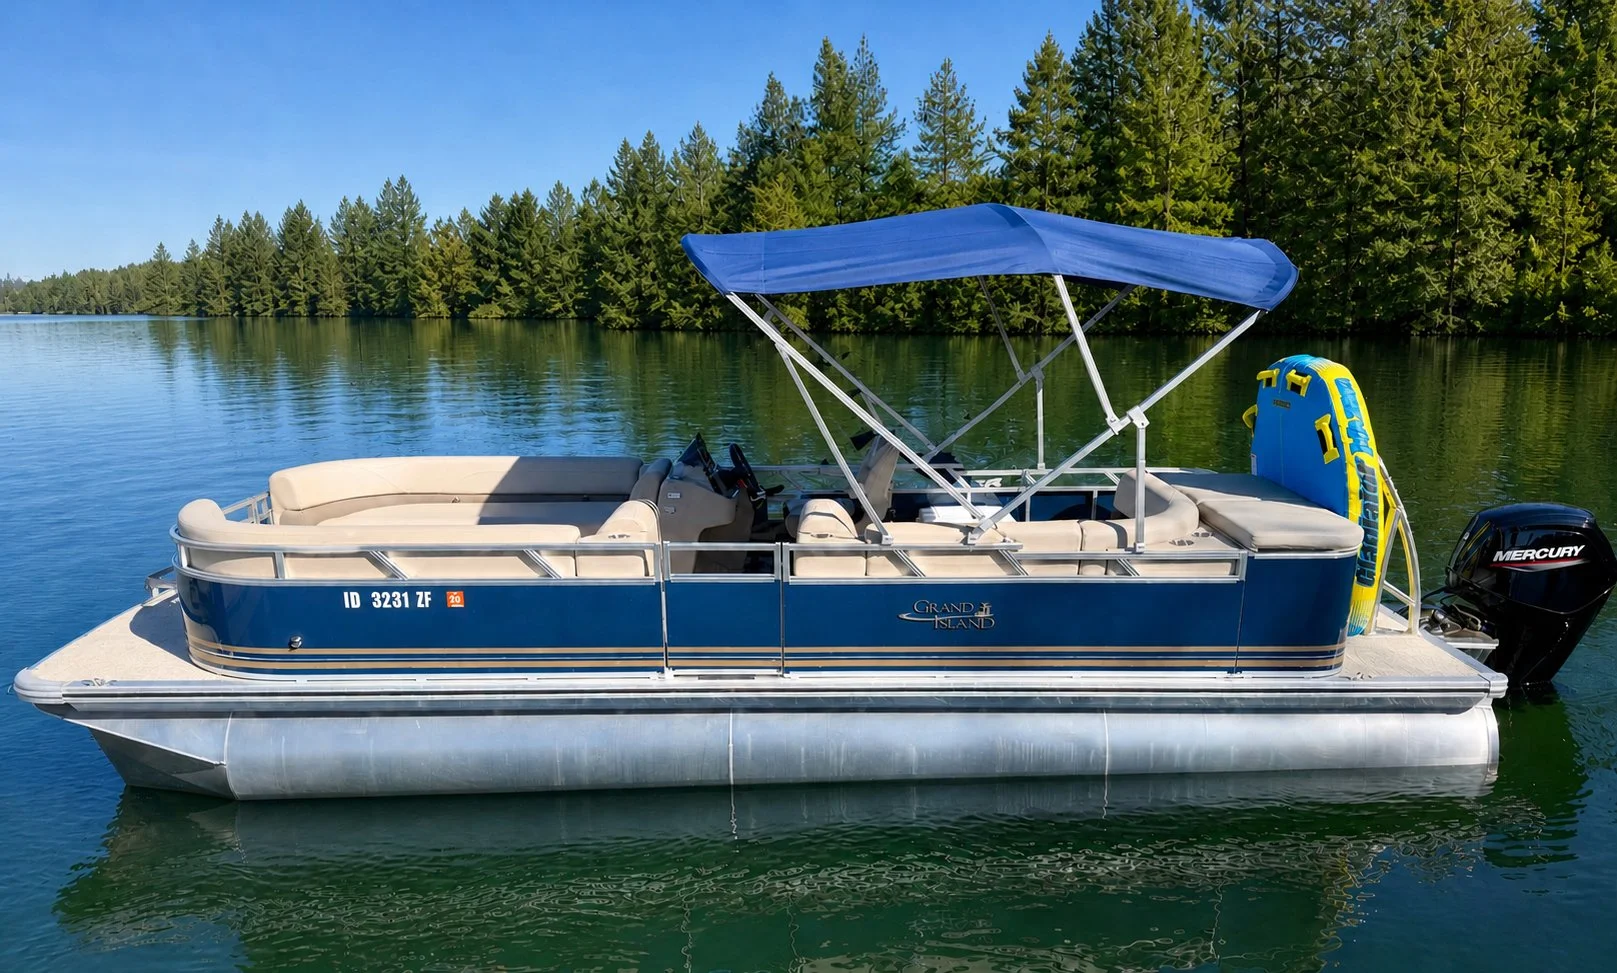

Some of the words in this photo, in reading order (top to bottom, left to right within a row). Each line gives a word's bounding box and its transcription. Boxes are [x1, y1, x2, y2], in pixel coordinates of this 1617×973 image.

[1492, 544, 1586, 562] MERCURY
[343, 591, 361, 609] ID
[371, 591, 410, 609] 3231
[416, 591, 432, 608] ZF
[449, 595, 461, 604] 20
[913, 599, 975, 614] GRAND
[934, 614, 996, 630] ISLAND
